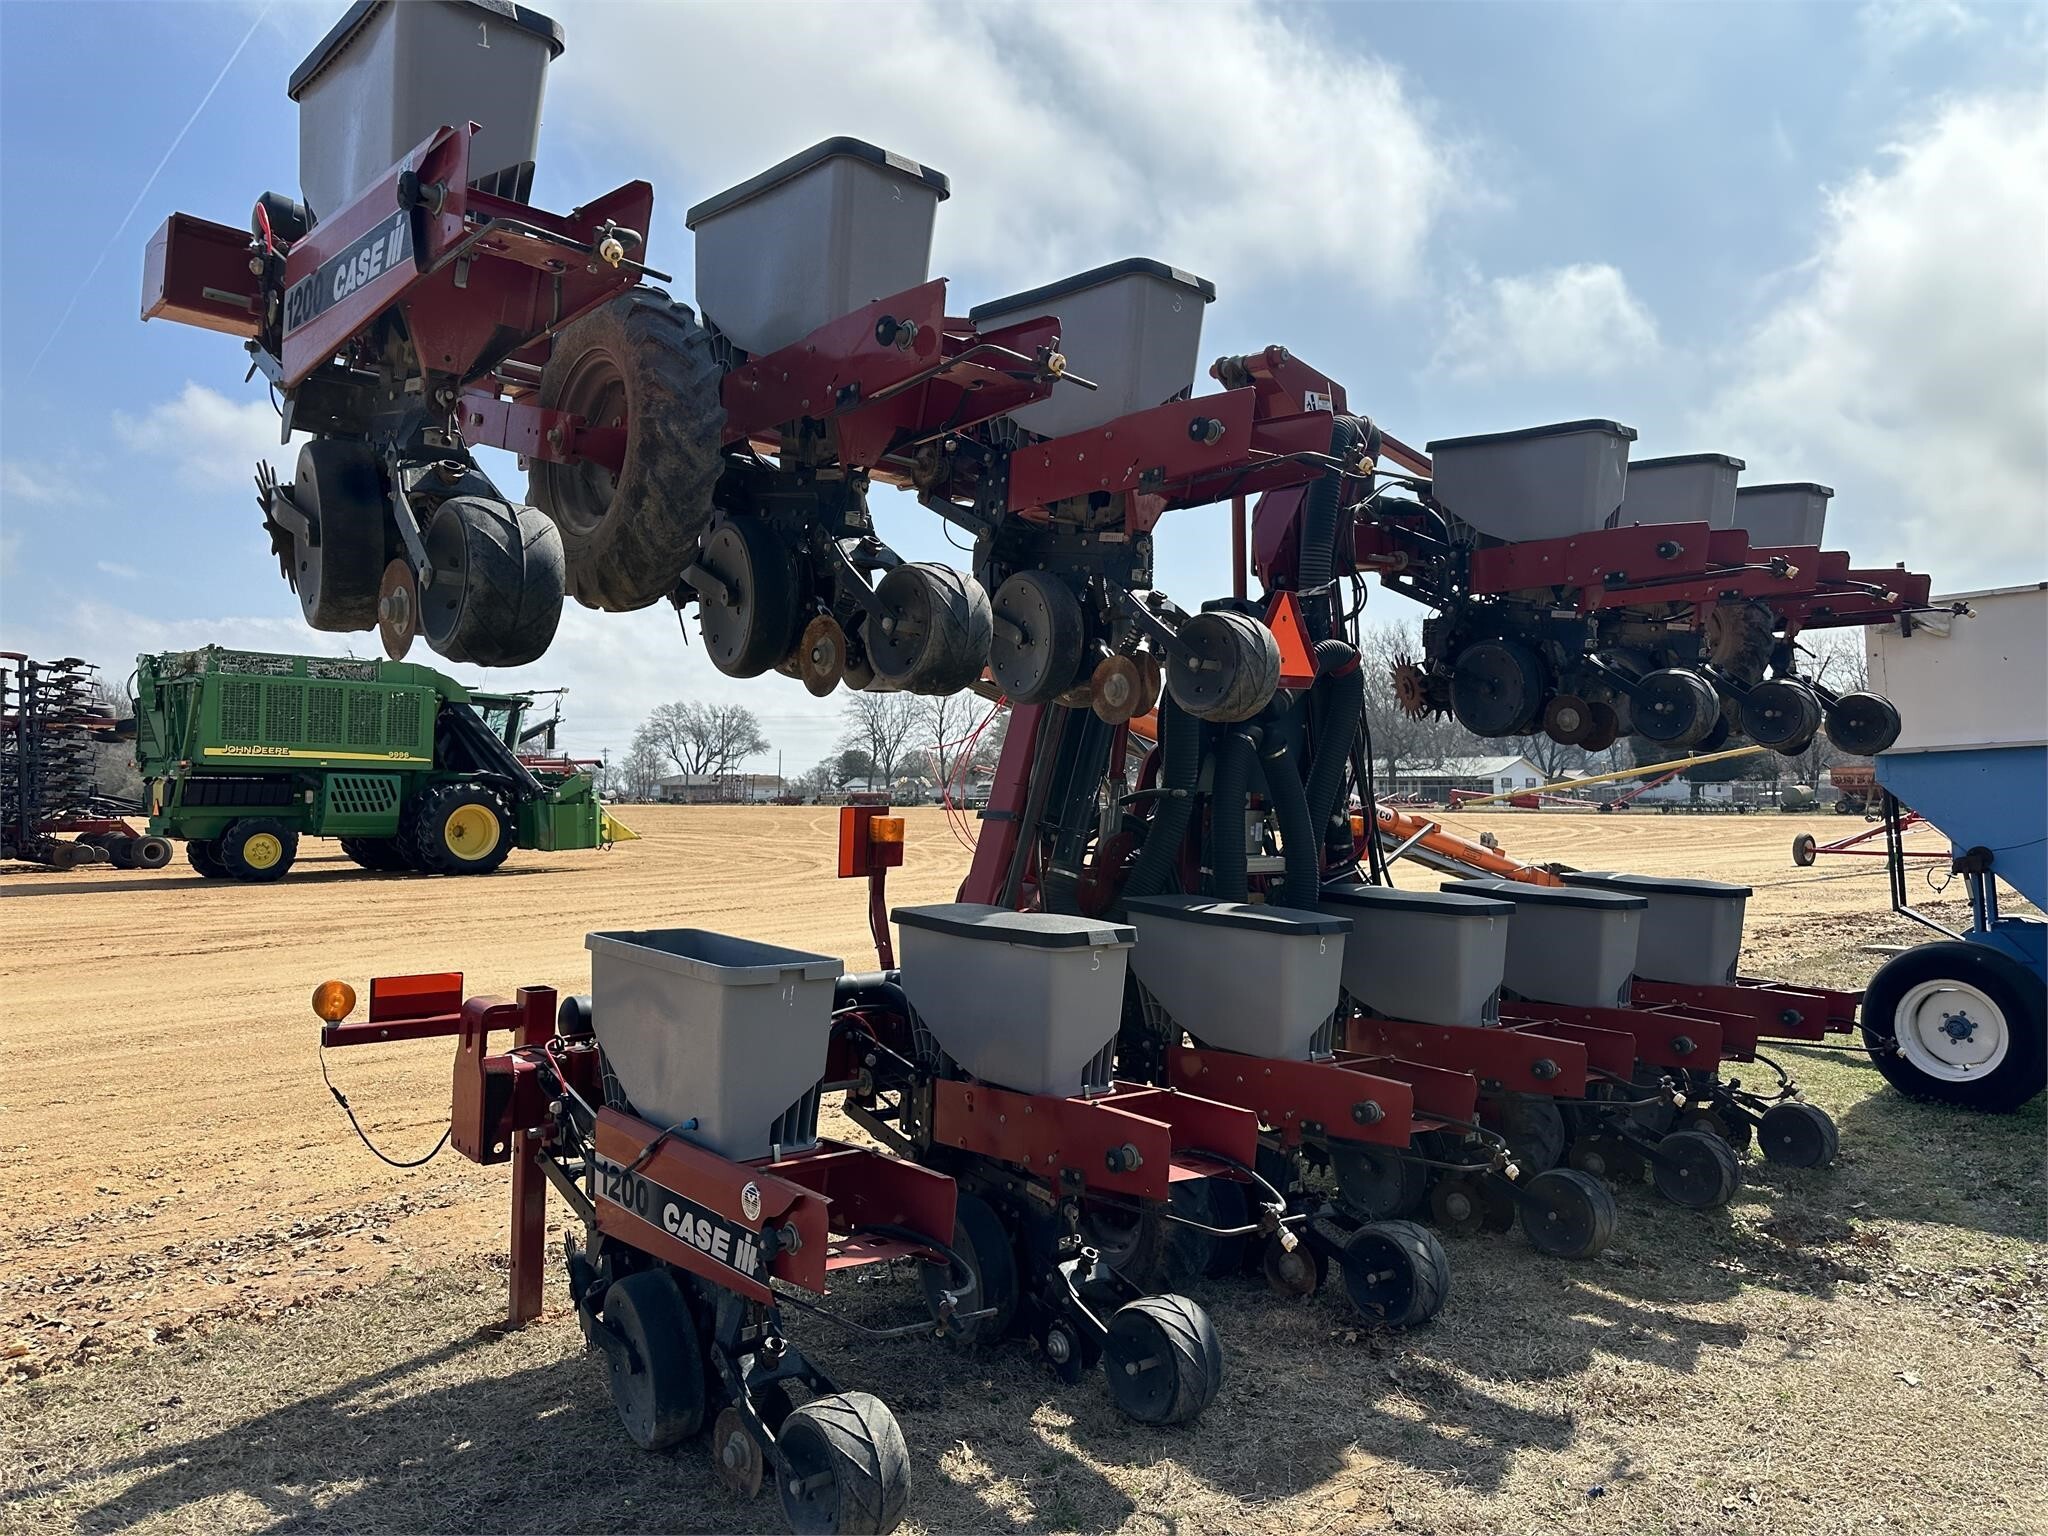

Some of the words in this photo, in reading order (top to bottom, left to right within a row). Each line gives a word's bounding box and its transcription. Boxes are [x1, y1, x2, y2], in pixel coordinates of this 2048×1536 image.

[477, 21, 490, 48] 1
[287, 277, 324, 332] 1200
[333, 237, 385, 301] CASE
[1319, 936, 1326, 955] 6
[1091, 950, 1102, 970] 5
[601, 1160, 649, 1216] 1200
[663, 1202, 731, 1261] CASE
